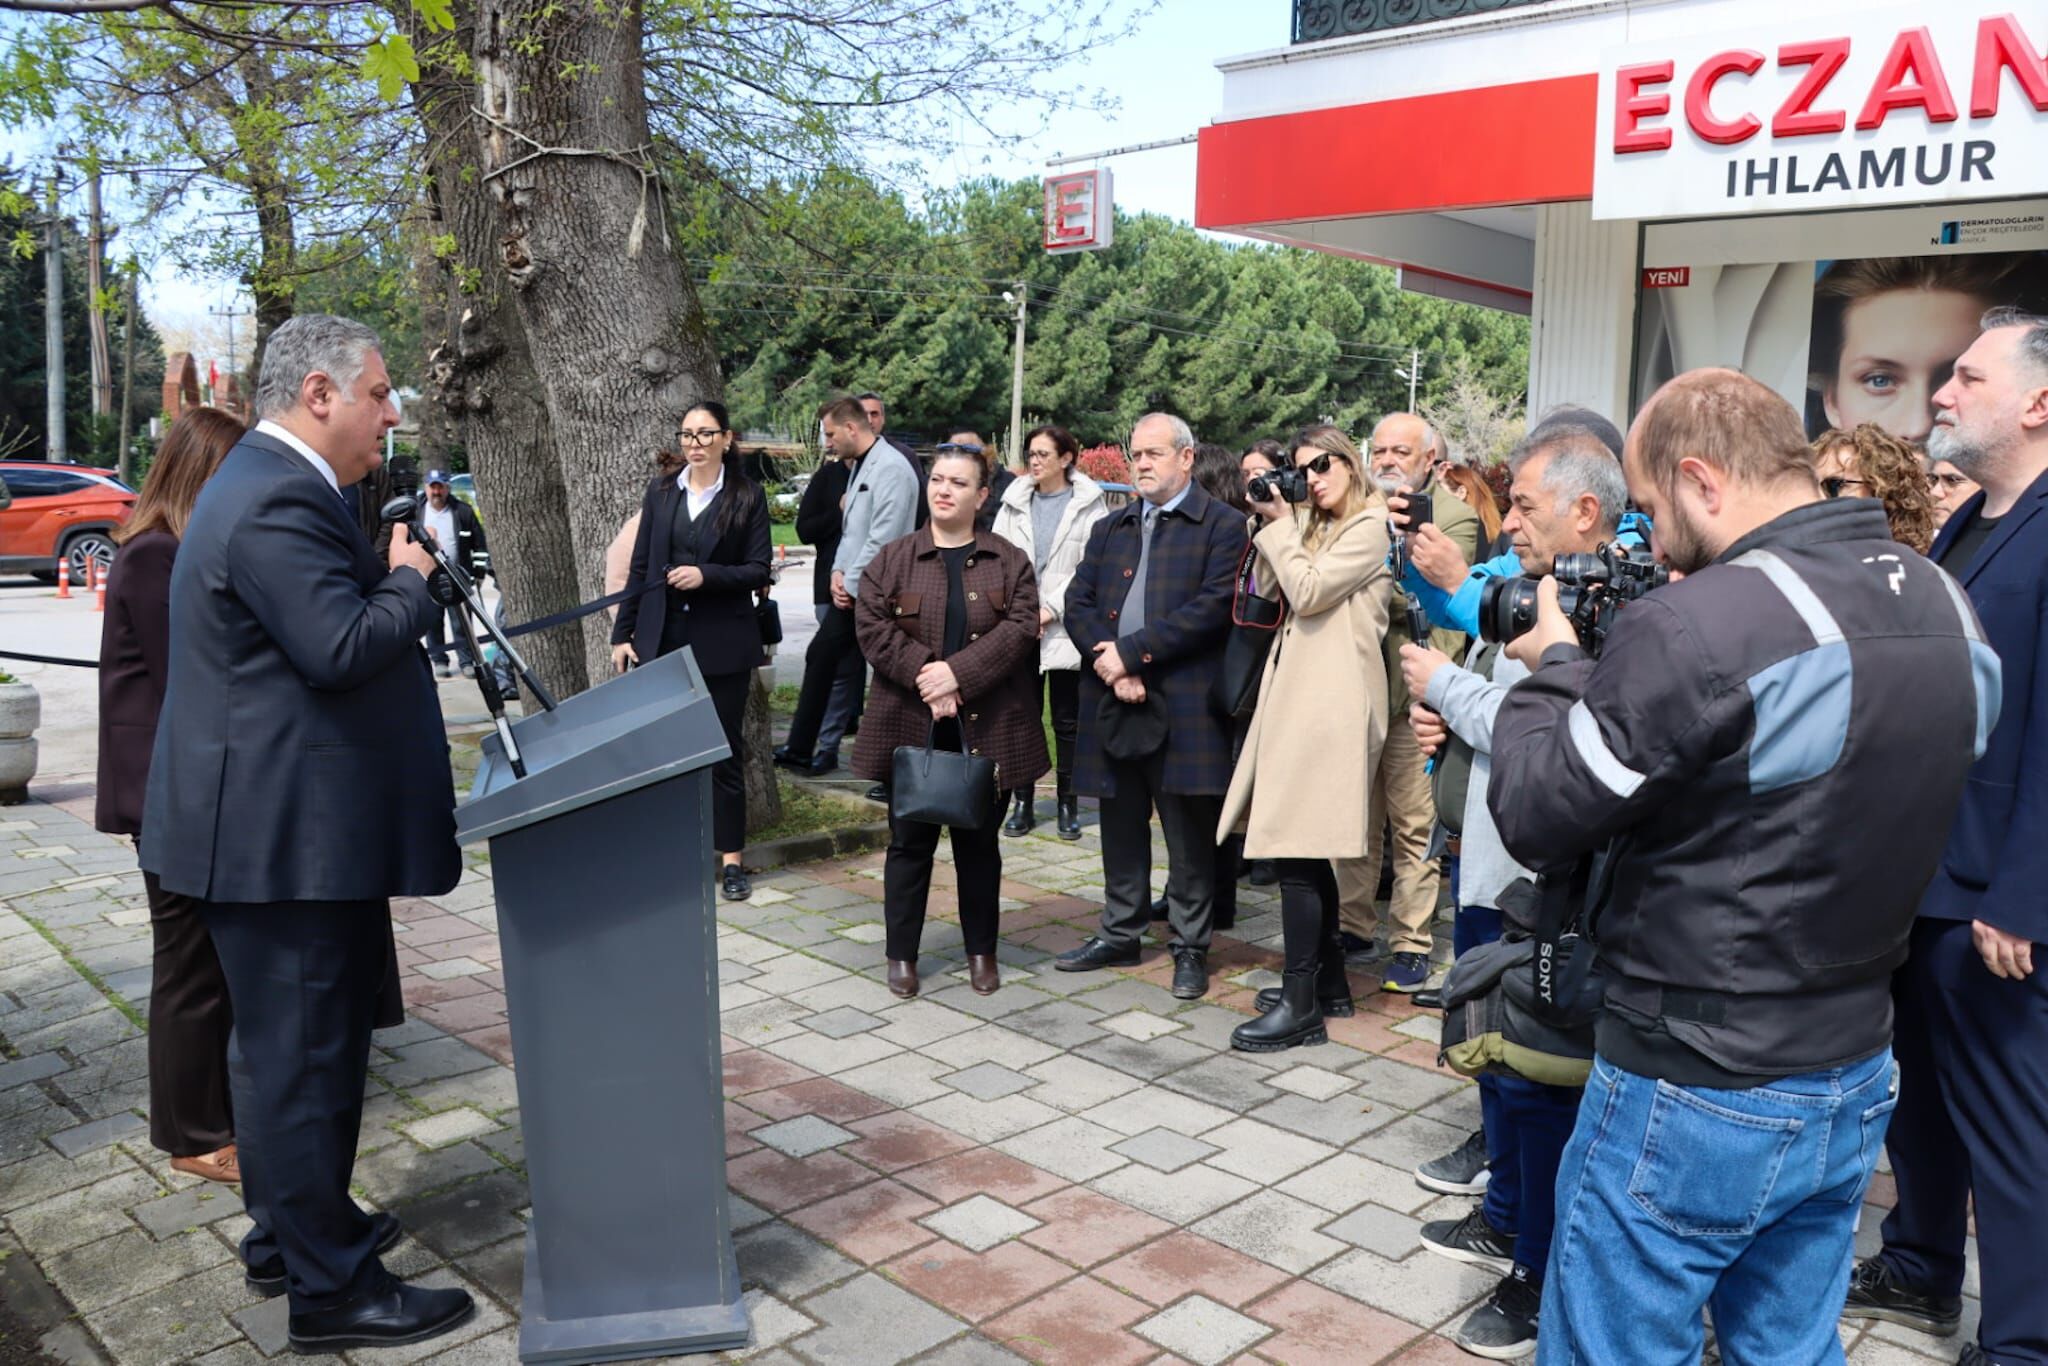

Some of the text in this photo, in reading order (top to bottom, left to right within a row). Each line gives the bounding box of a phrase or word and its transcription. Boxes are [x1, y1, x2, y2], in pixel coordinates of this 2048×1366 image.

[1613, 12, 2048, 154] ECZAN
[1726, 140, 1996, 198] IHLAMUR
[1056, 180, 1085, 237] E
[1648, 269, 1684, 285] YENİ
[1539, 942, 1553, 1004] SONY
